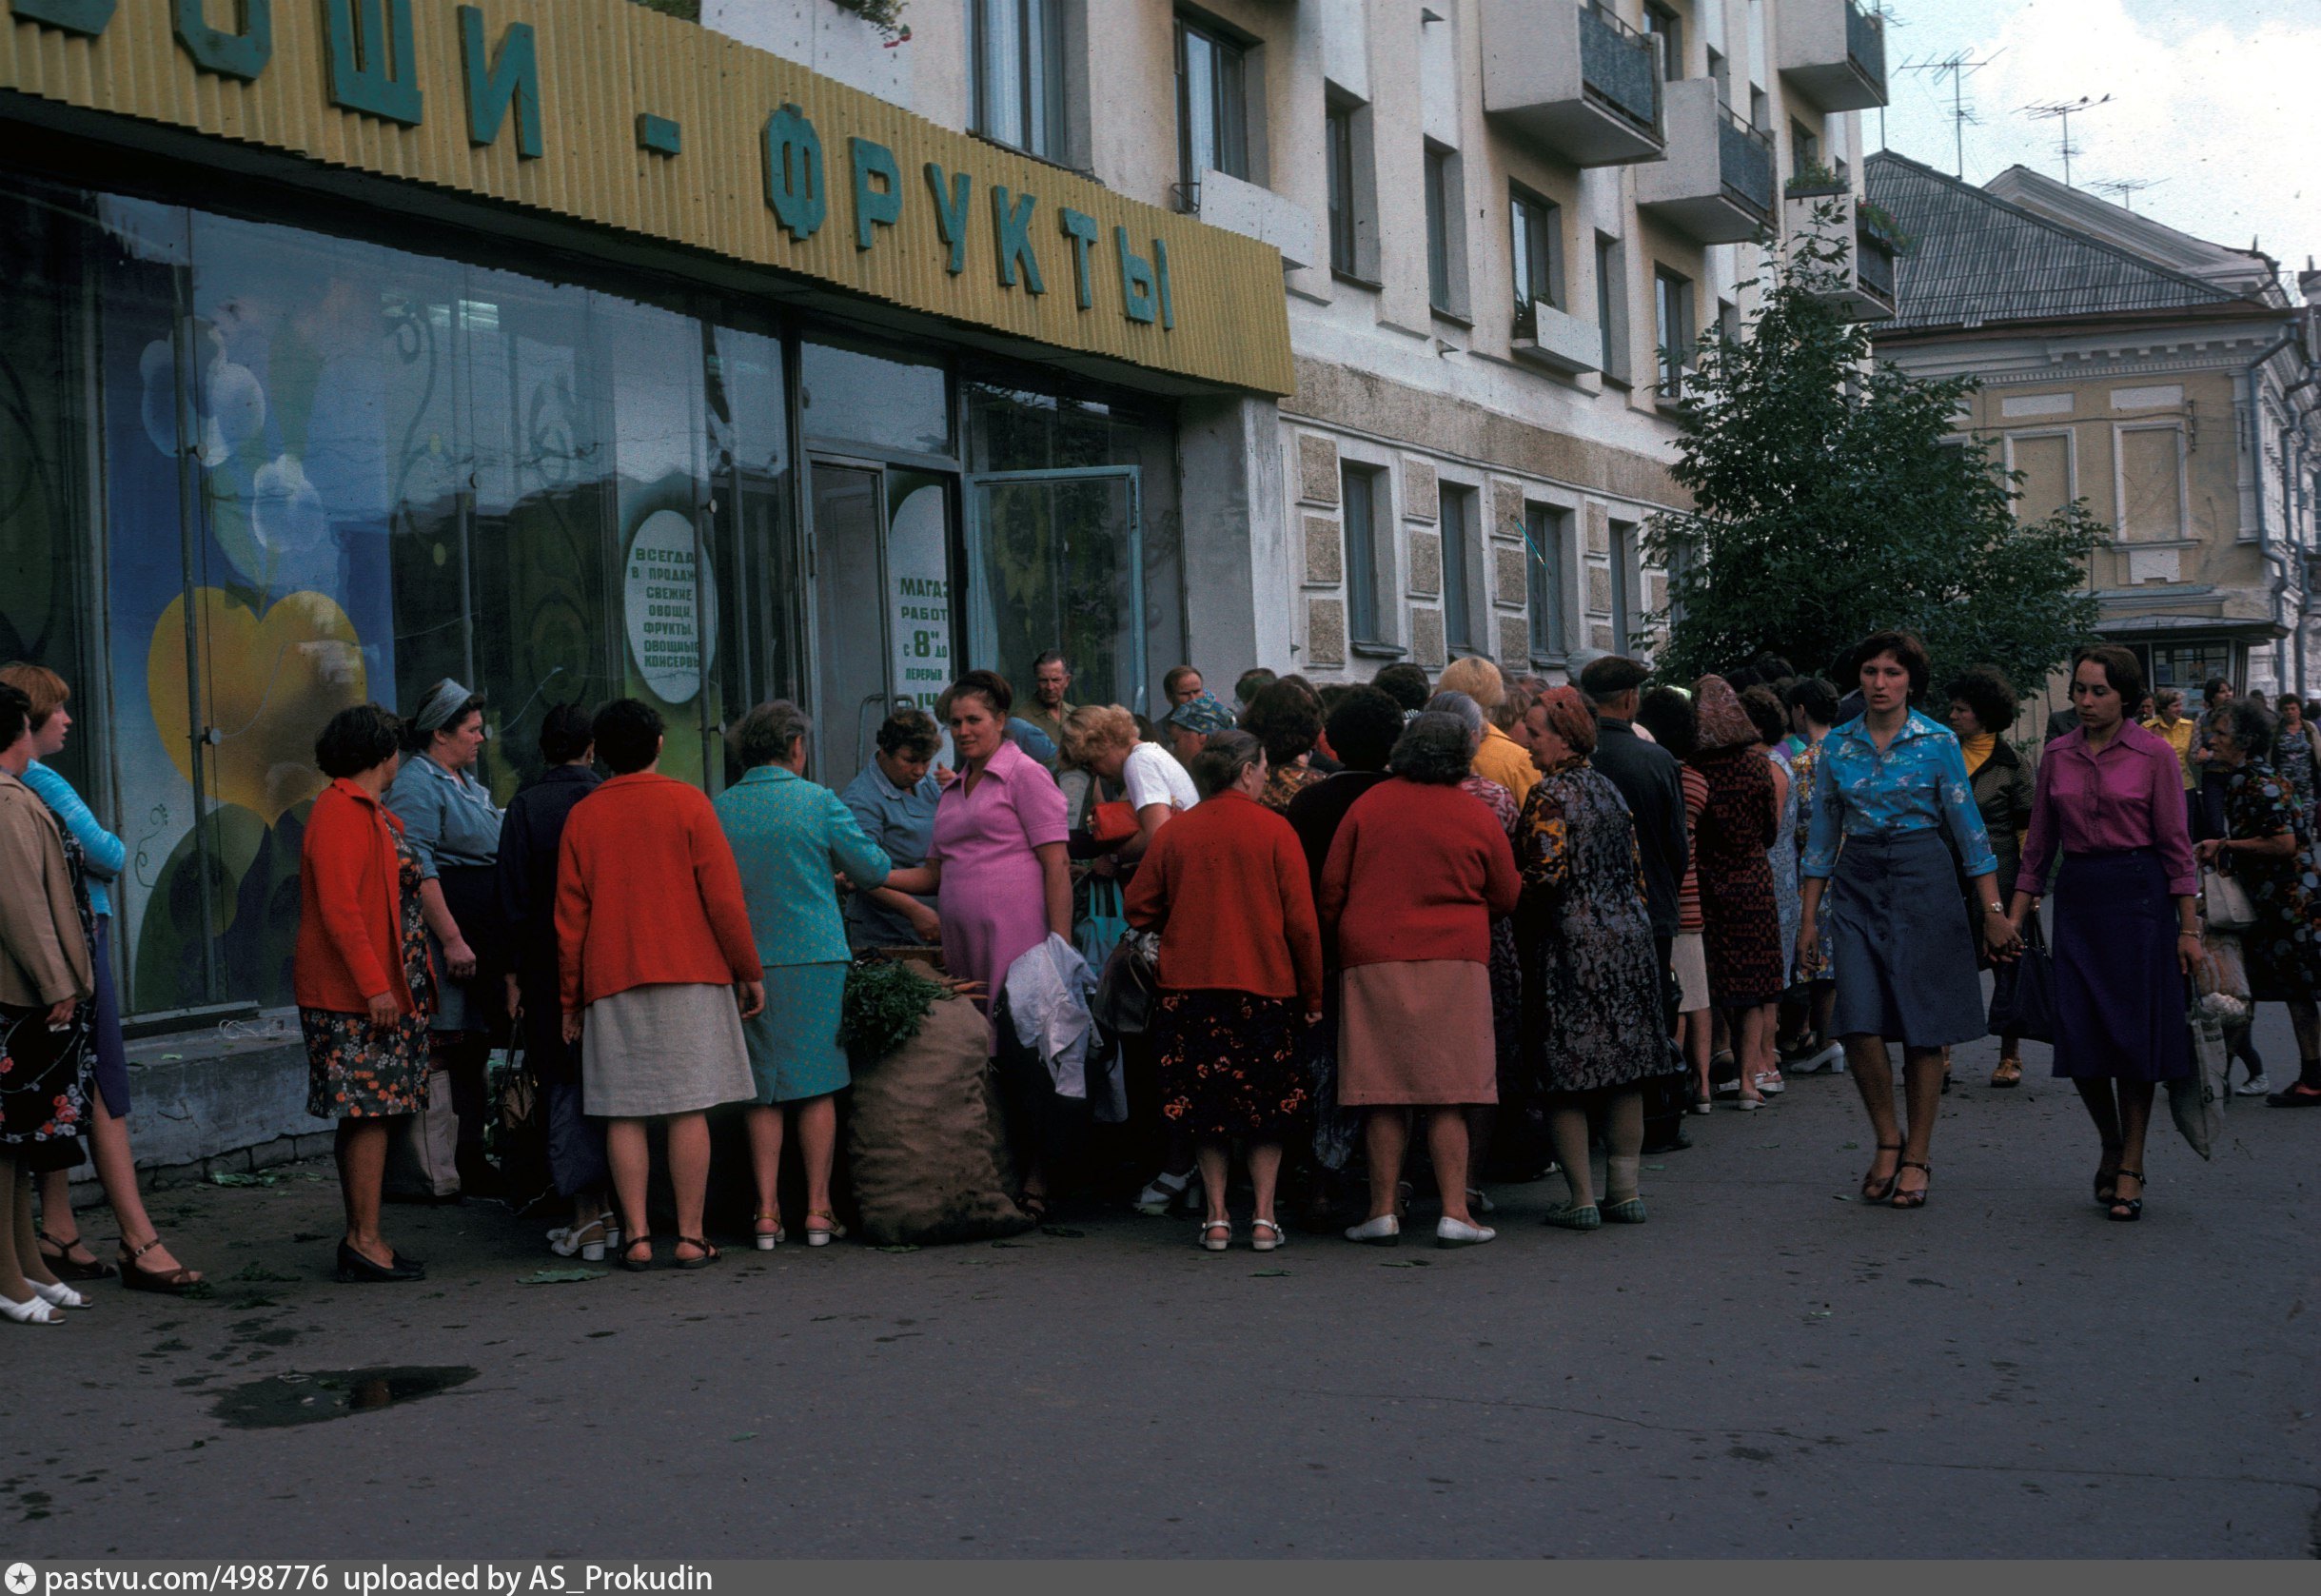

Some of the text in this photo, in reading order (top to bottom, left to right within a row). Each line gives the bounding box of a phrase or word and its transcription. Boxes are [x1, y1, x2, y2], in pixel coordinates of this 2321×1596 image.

[762, 102, 1174, 330] ФРУКТЫ
[635, 547, 695, 563] ВСЕГДА
[631, 565, 639, 579] В
[646, 586, 693, 601] СВЕЖИЕ
[905, 668, 943, 681] ПЕРЕРЫВ
